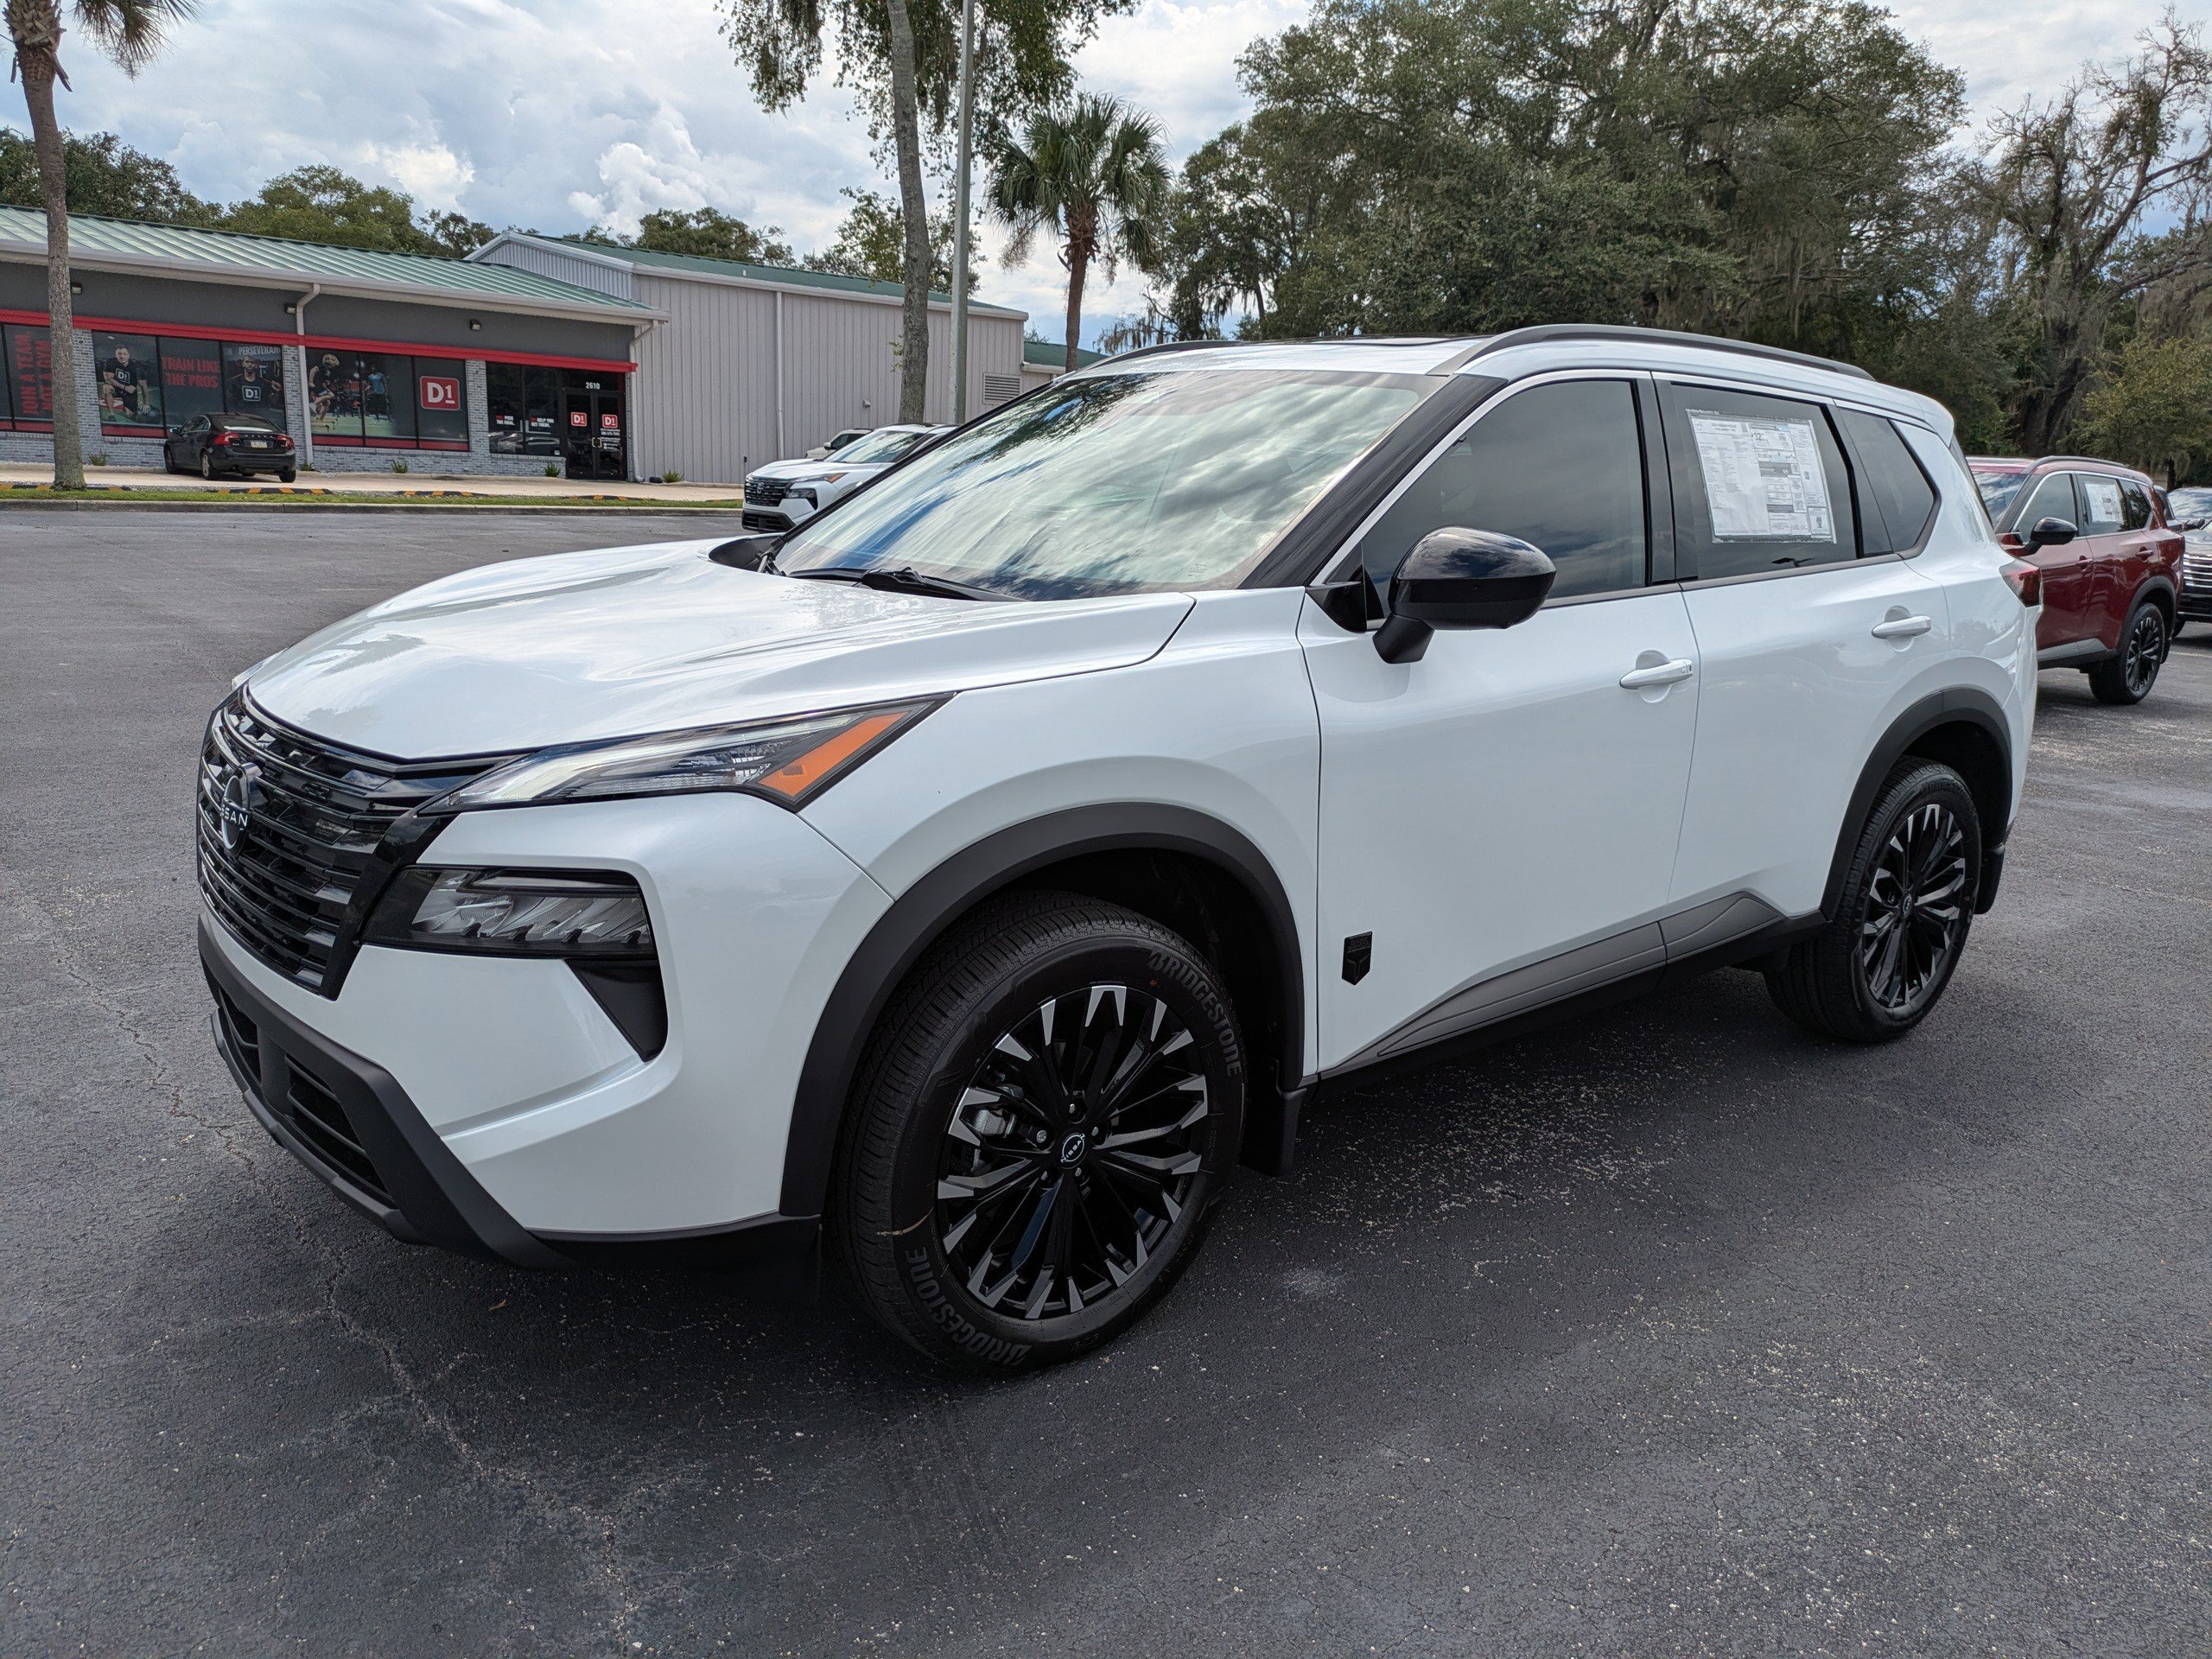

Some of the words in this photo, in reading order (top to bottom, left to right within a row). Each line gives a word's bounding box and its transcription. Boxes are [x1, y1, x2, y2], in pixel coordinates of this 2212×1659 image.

[162, 356, 194, 372] TRAIN
[197, 359, 219, 374] LIKE
[165, 372, 186, 387] THE
[188, 374, 219, 388] PROS
[245, 389, 259, 399] D1
[426, 381, 455, 404] D1
[1147, 948, 1243, 1077] BRIDGESTONE
[905, 1246, 1033, 1366] BRIDGESTONE
